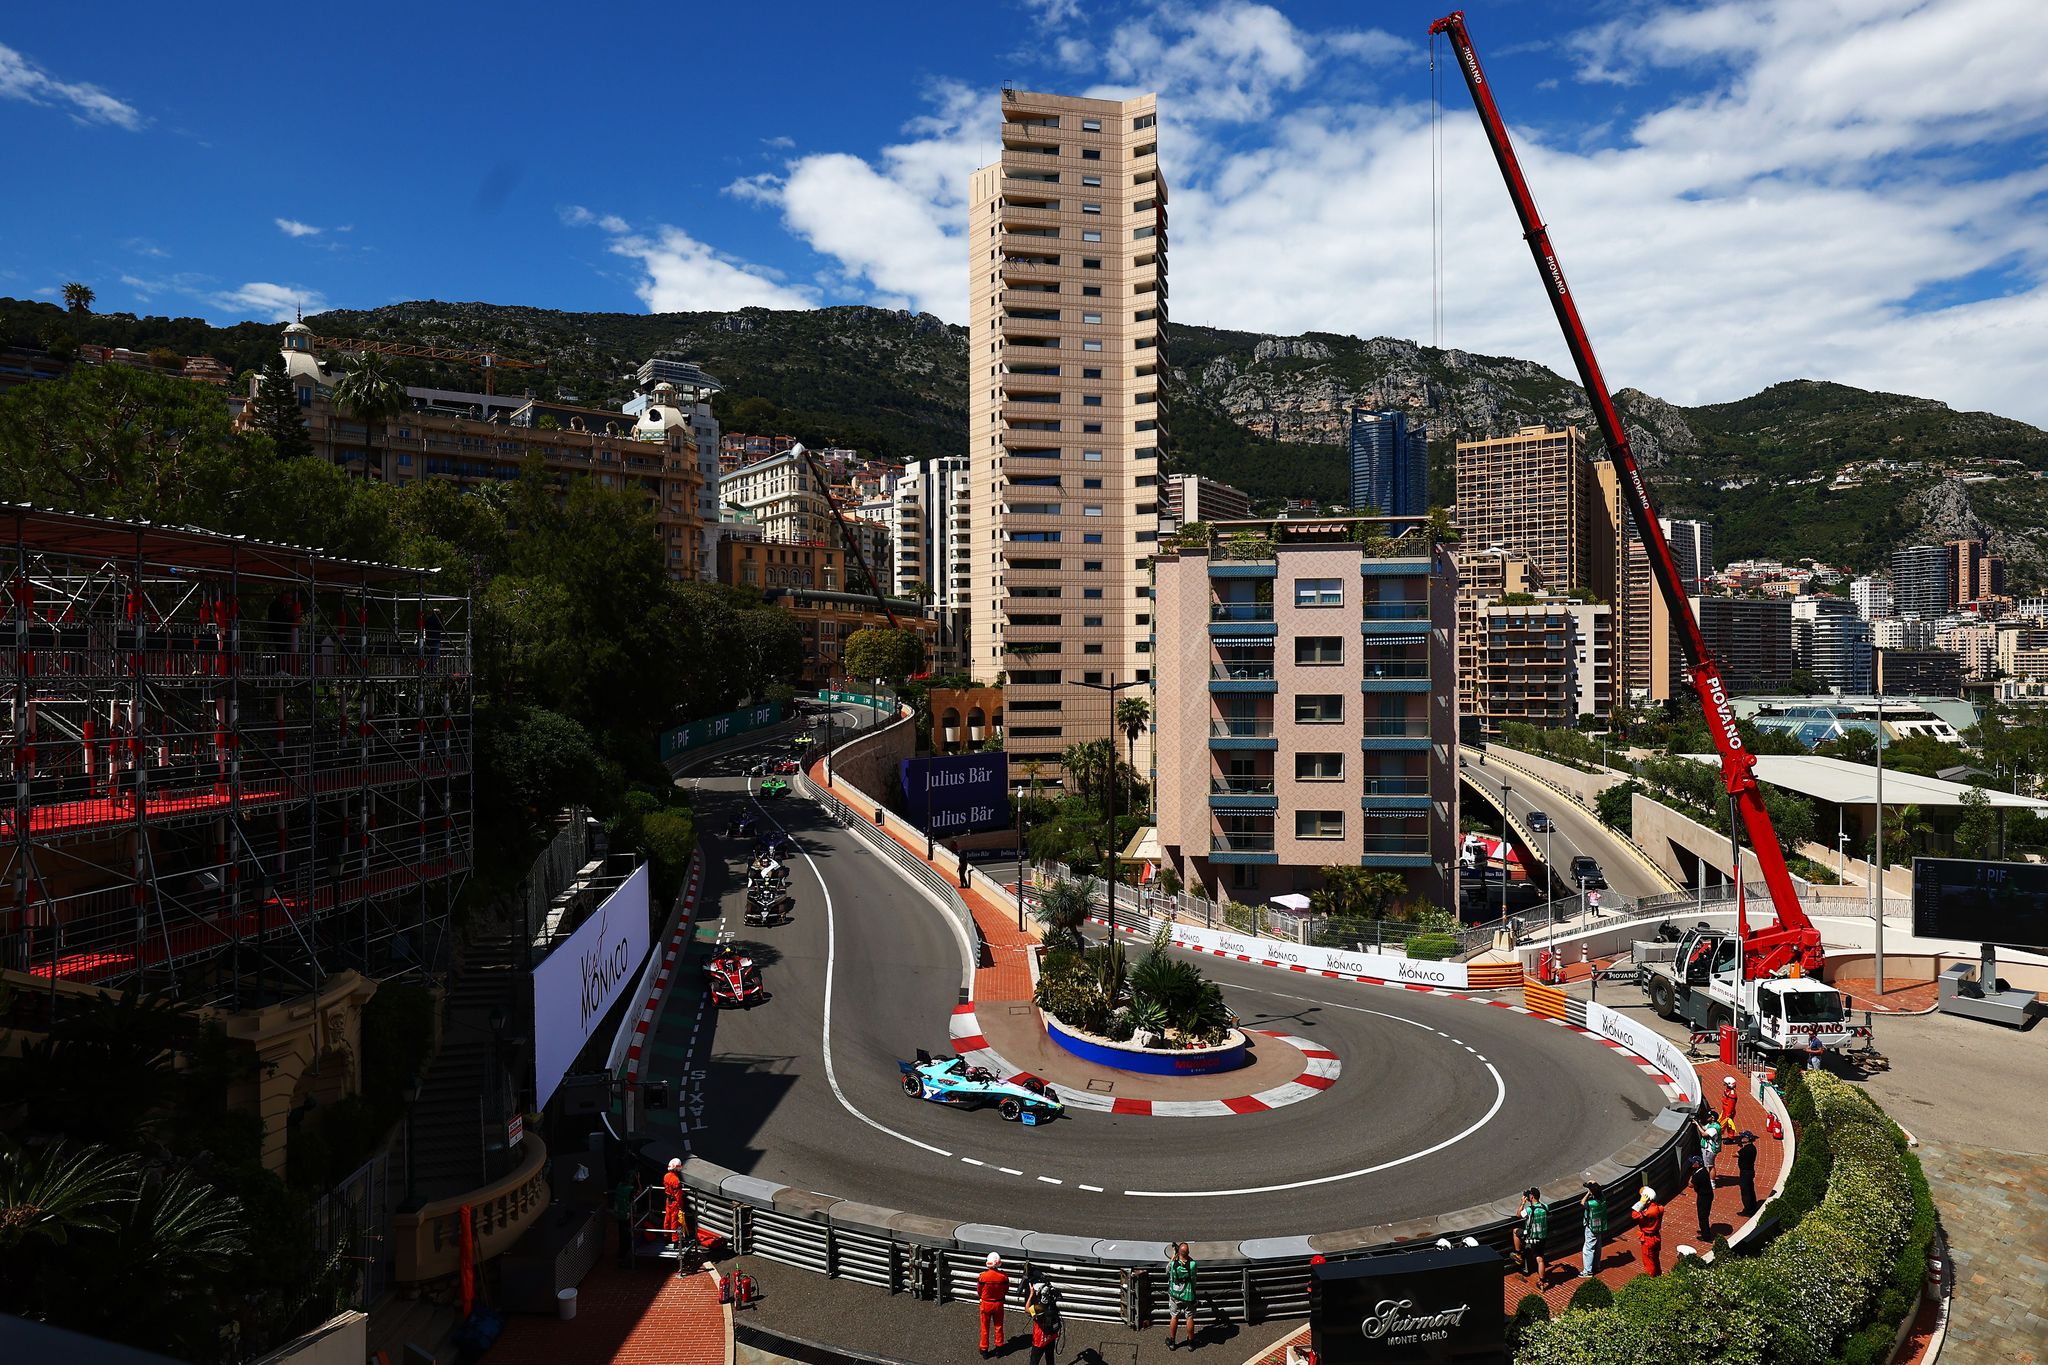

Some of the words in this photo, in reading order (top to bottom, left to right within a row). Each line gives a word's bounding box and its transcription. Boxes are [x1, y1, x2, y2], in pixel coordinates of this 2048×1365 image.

[1462, 45, 1482, 84] PIOVANO
[1546, 255, 1566, 295] PIOVANO
[1629, 469, 1650, 510] PIOVANO
[756, 708, 771, 725] PIF
[1706, 676, 1742, 750] PIOVANO
[715, 718, 730, 736] PIF
[677, 729, 689, 748] PIF
[925, 771, 965, 791] Julius
[968, 767, 993, 784] Bär
[932, 810, 966, 828] ulius
[970, 806, 994, 823] Bär
[1987, 868, 2008, 883] PIF
[1219, 941, 1245, 953] MONACO
[1267, 950, 1298, 963] MONACO
[1326, 960, 1363, 972] MONACO
[1398, 969, 1445, 982] MONACO
[580, 937, 629, 1037] MONACO
[1602, 1023, 1634, 1047] MONACO
[688, 1070, 709, 1130] TAXIS
[1362, 1299, 1471, 1339] Fairmont
[1387, 1334, 1418, 1346] MONTE
[1421, 1329, 1448, 1341] CARLO
